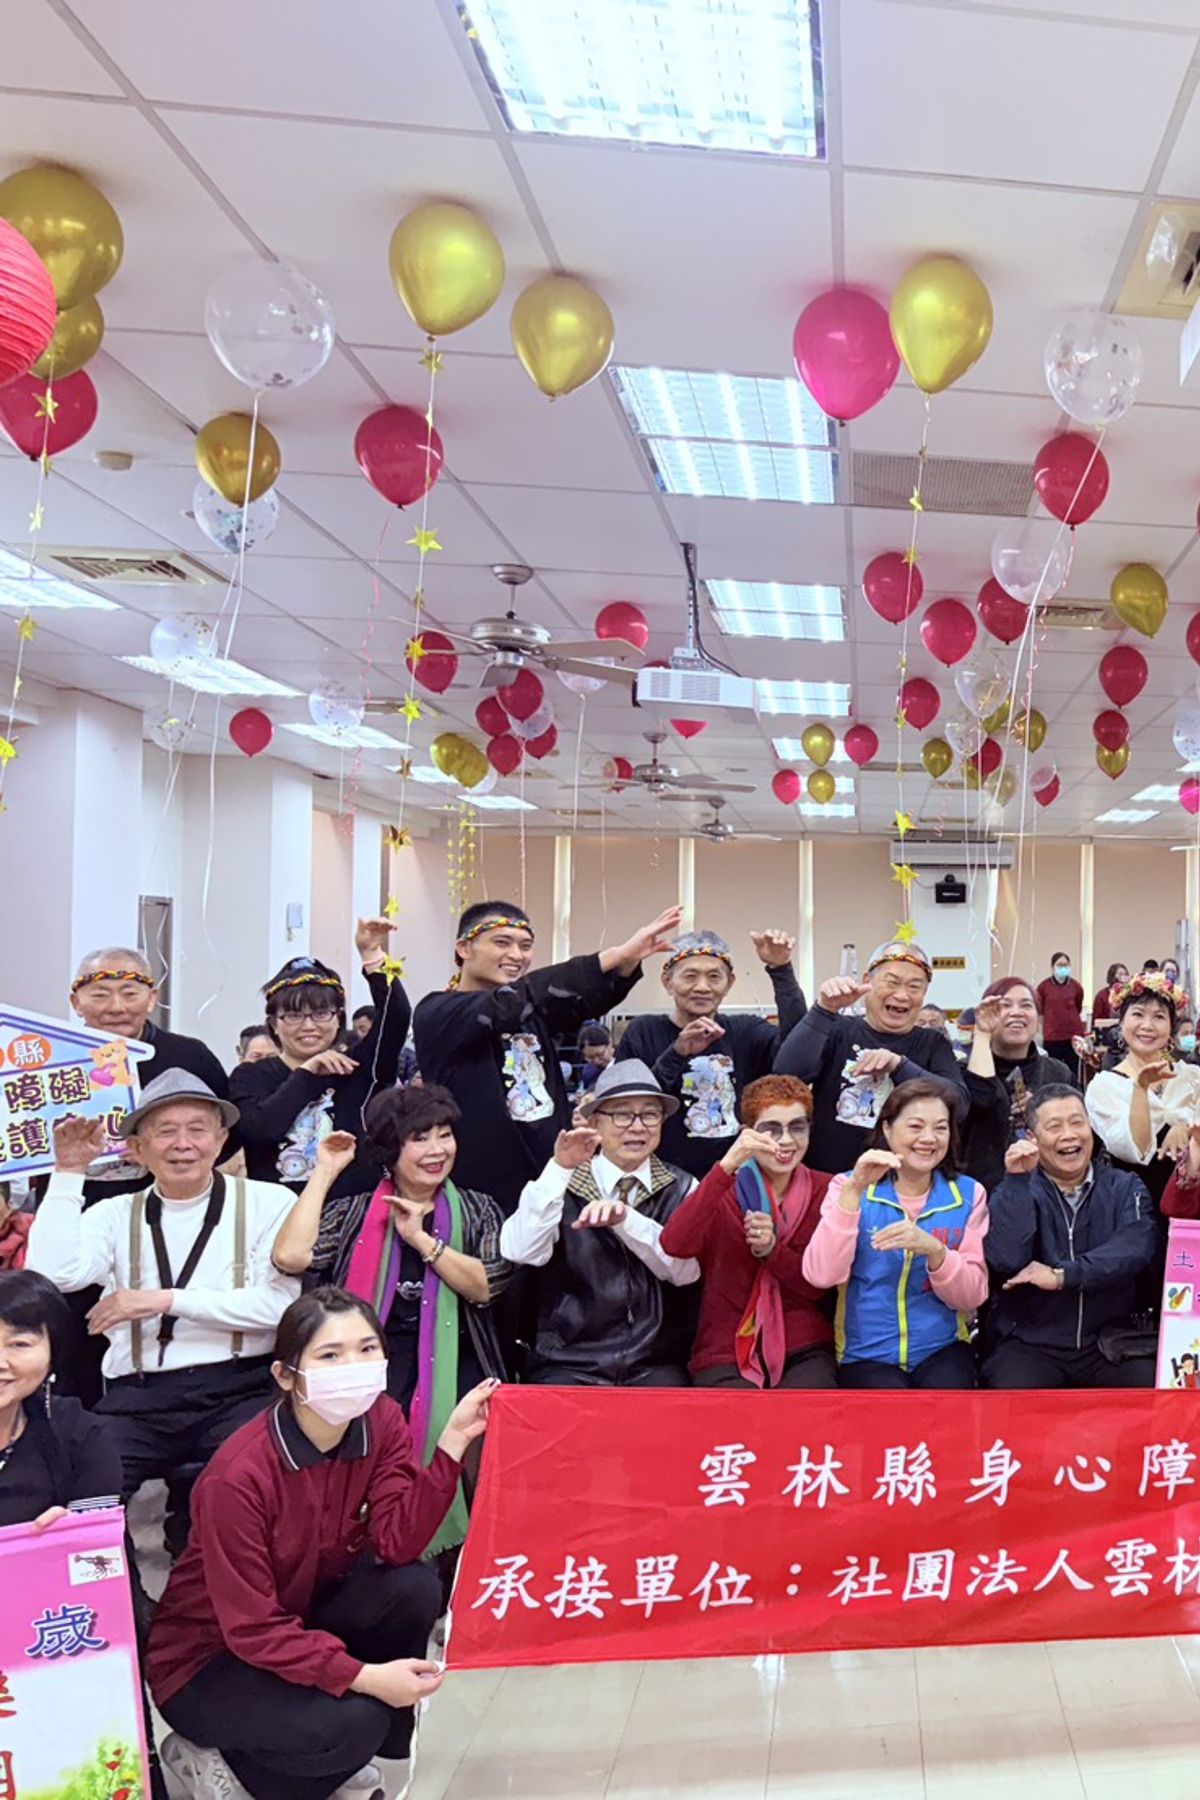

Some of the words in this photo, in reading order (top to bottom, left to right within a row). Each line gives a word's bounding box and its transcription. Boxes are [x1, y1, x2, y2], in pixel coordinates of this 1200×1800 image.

[13, 1037, 46, 1066] 縣
[4, 1066, 91, 1114] 障礙
[26, 1604, 107, 1660] 歲
